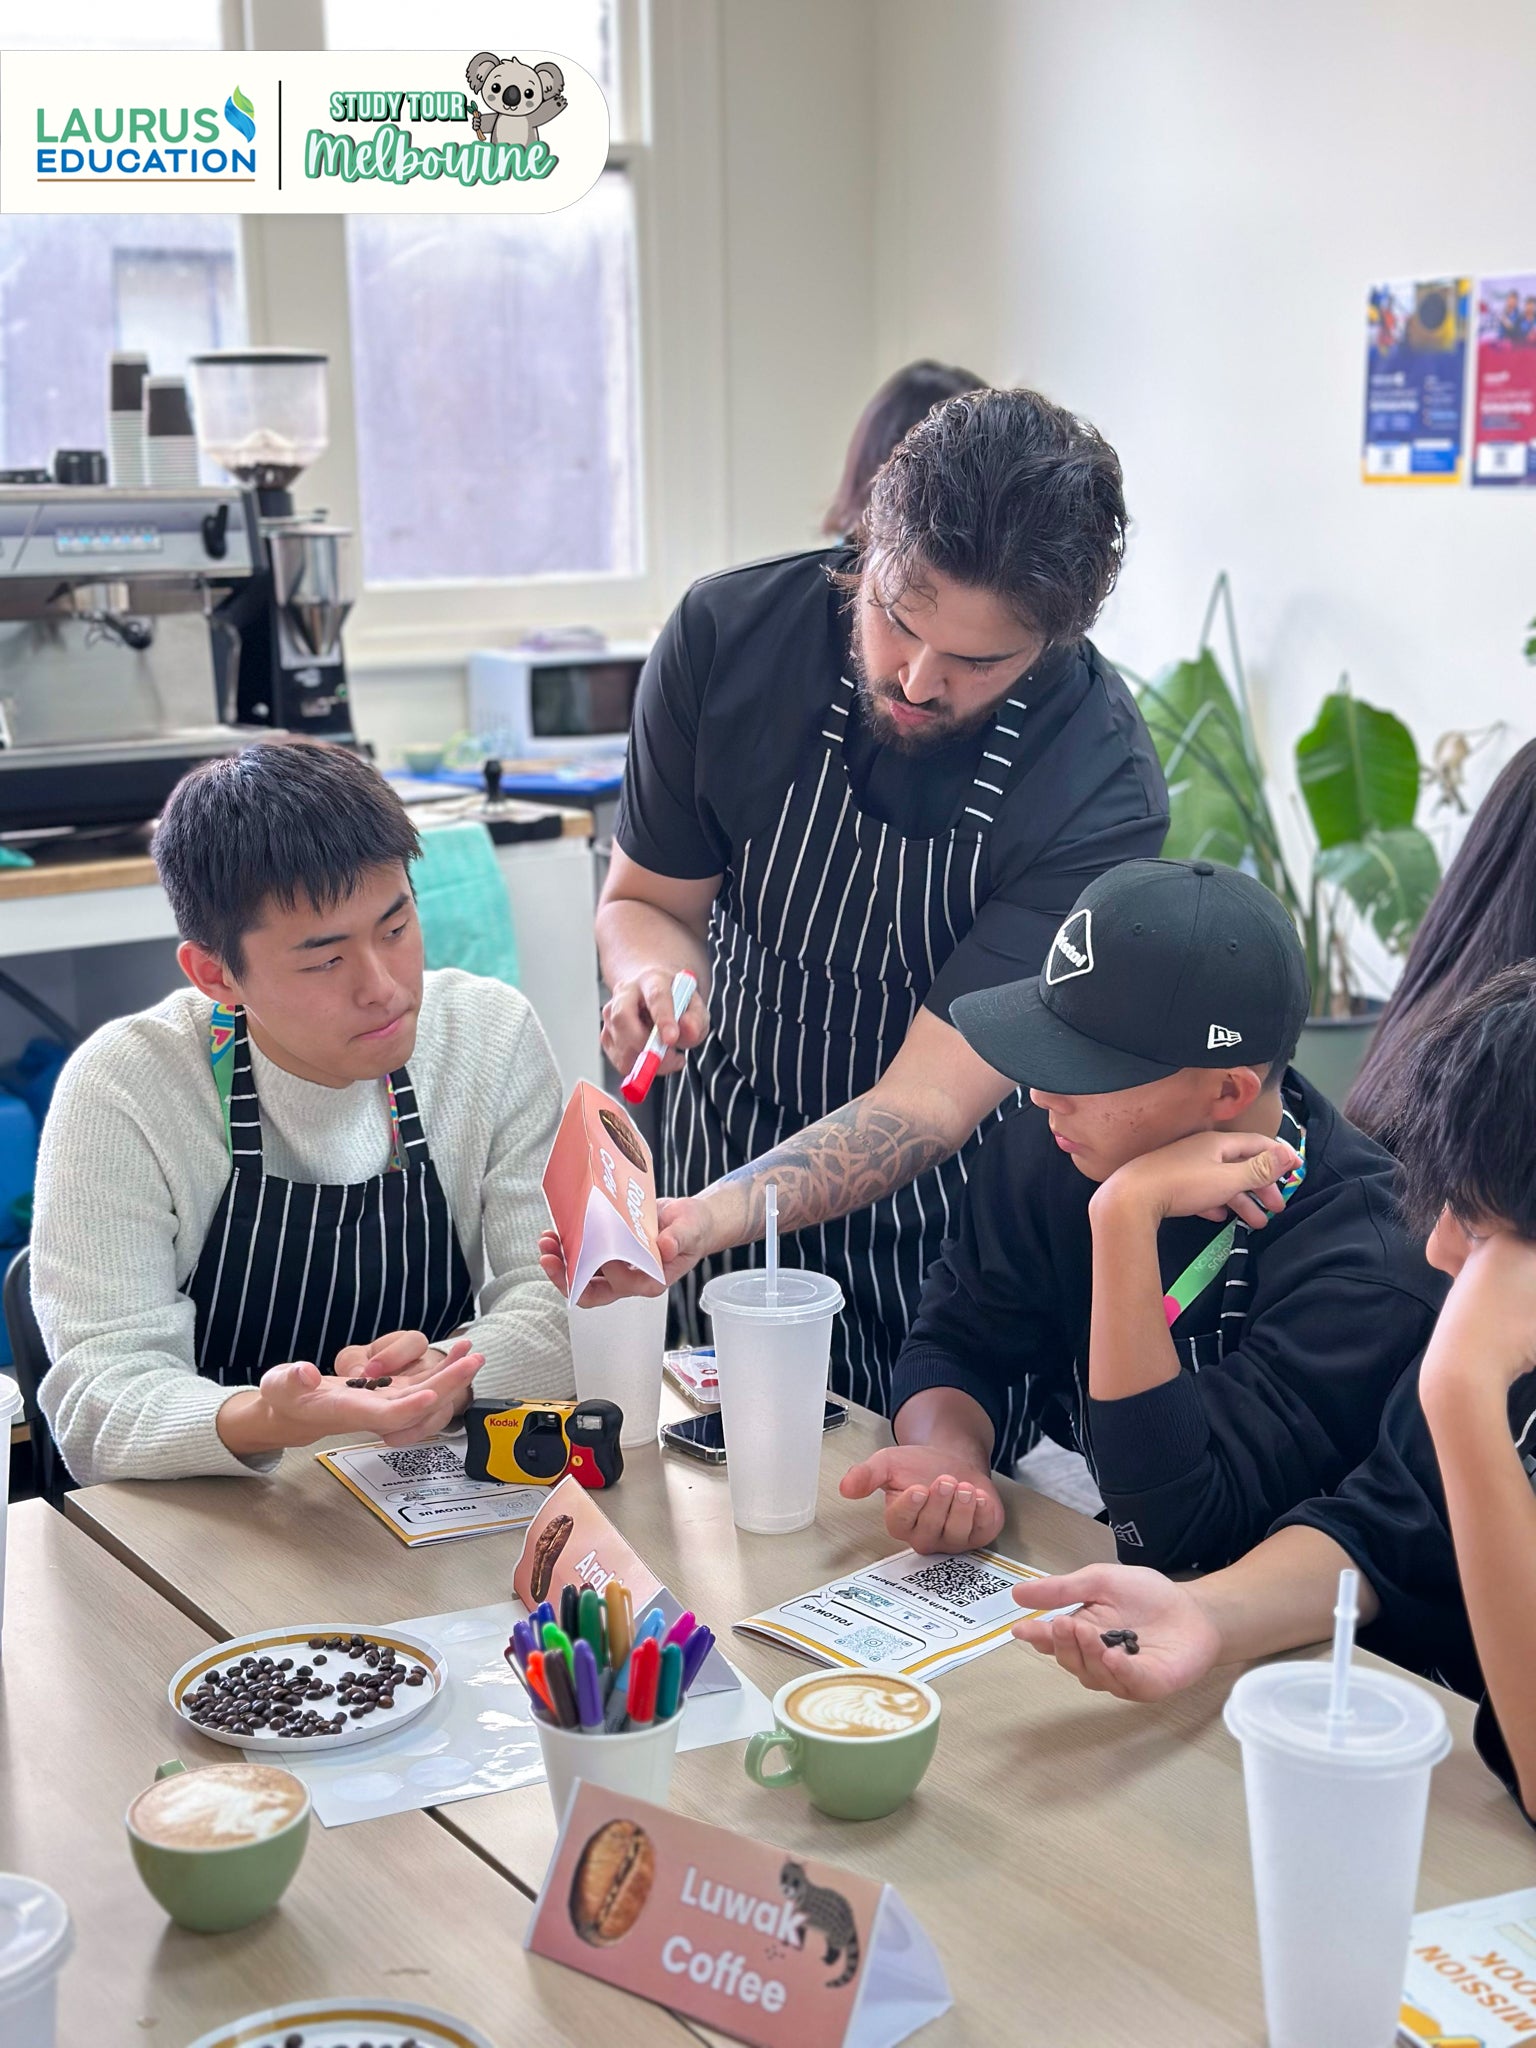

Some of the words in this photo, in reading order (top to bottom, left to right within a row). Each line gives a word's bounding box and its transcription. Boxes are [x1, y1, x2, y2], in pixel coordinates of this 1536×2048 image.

[489, 1417, 519, 1428] Kodak
[418, 1509, 434, 1518] US
[434, 1504, 478, 1515] FOLLOW
[574, 1549, 624, 1599] Arab
[867, 1573, 898, 1587] photos
[896, 1585, 919, 1597] your
[917, 1594, 930, 1603] us
[801, 1603, 816, 1611] US
[929, 1600, 949, 1613] with
[813, 1608, 855, 1627] FOLLOW
[949, 1607, 977, 1625] Share
[680, 1866, 808, 1948] Luwak
[661, 1935, 787, 2013] Coffee
[1469, 1951, 1536, 2005] OOK
[1414, 1945, 1536, 2031] MISSION
